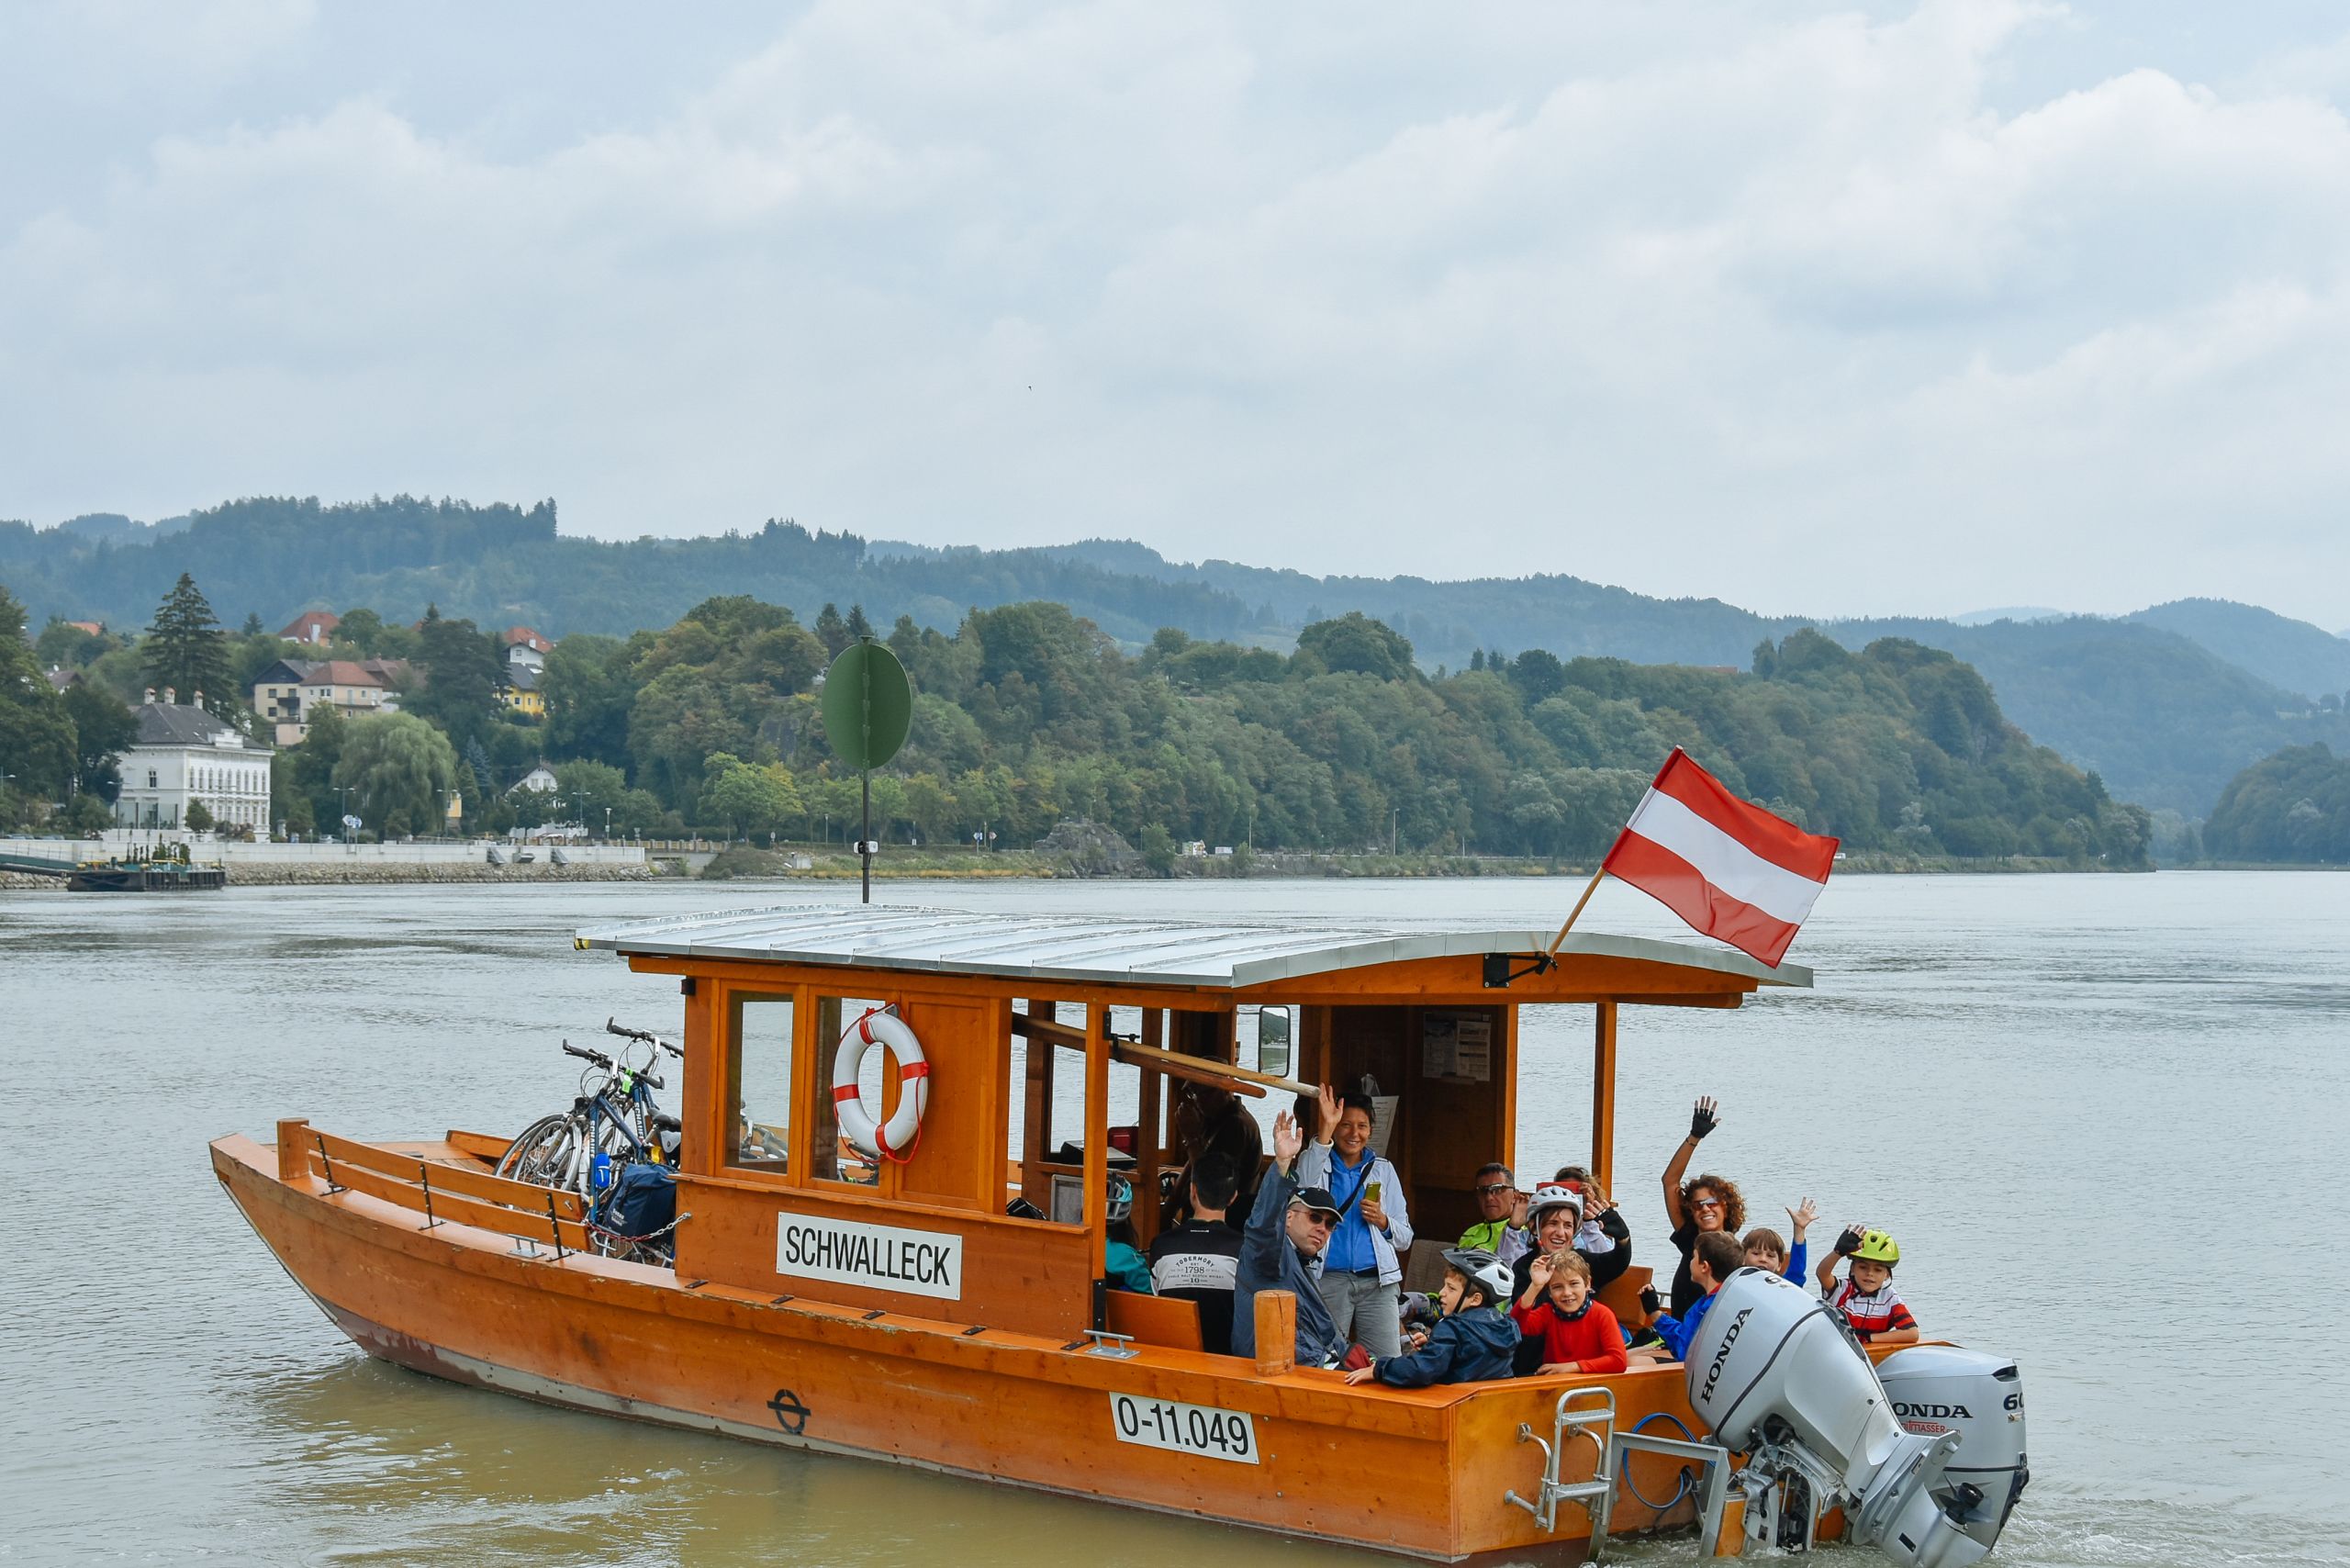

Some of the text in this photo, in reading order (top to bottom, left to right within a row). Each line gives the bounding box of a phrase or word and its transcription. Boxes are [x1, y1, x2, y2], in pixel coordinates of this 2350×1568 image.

[785, 1225, 951, 1287] SCHWALLECK
[1185, 1266, 1205, 1274] 1798
[1700, 1306, 1754, 1406] HONDA
[1891, 1402, 1974, 1419] ONDA
